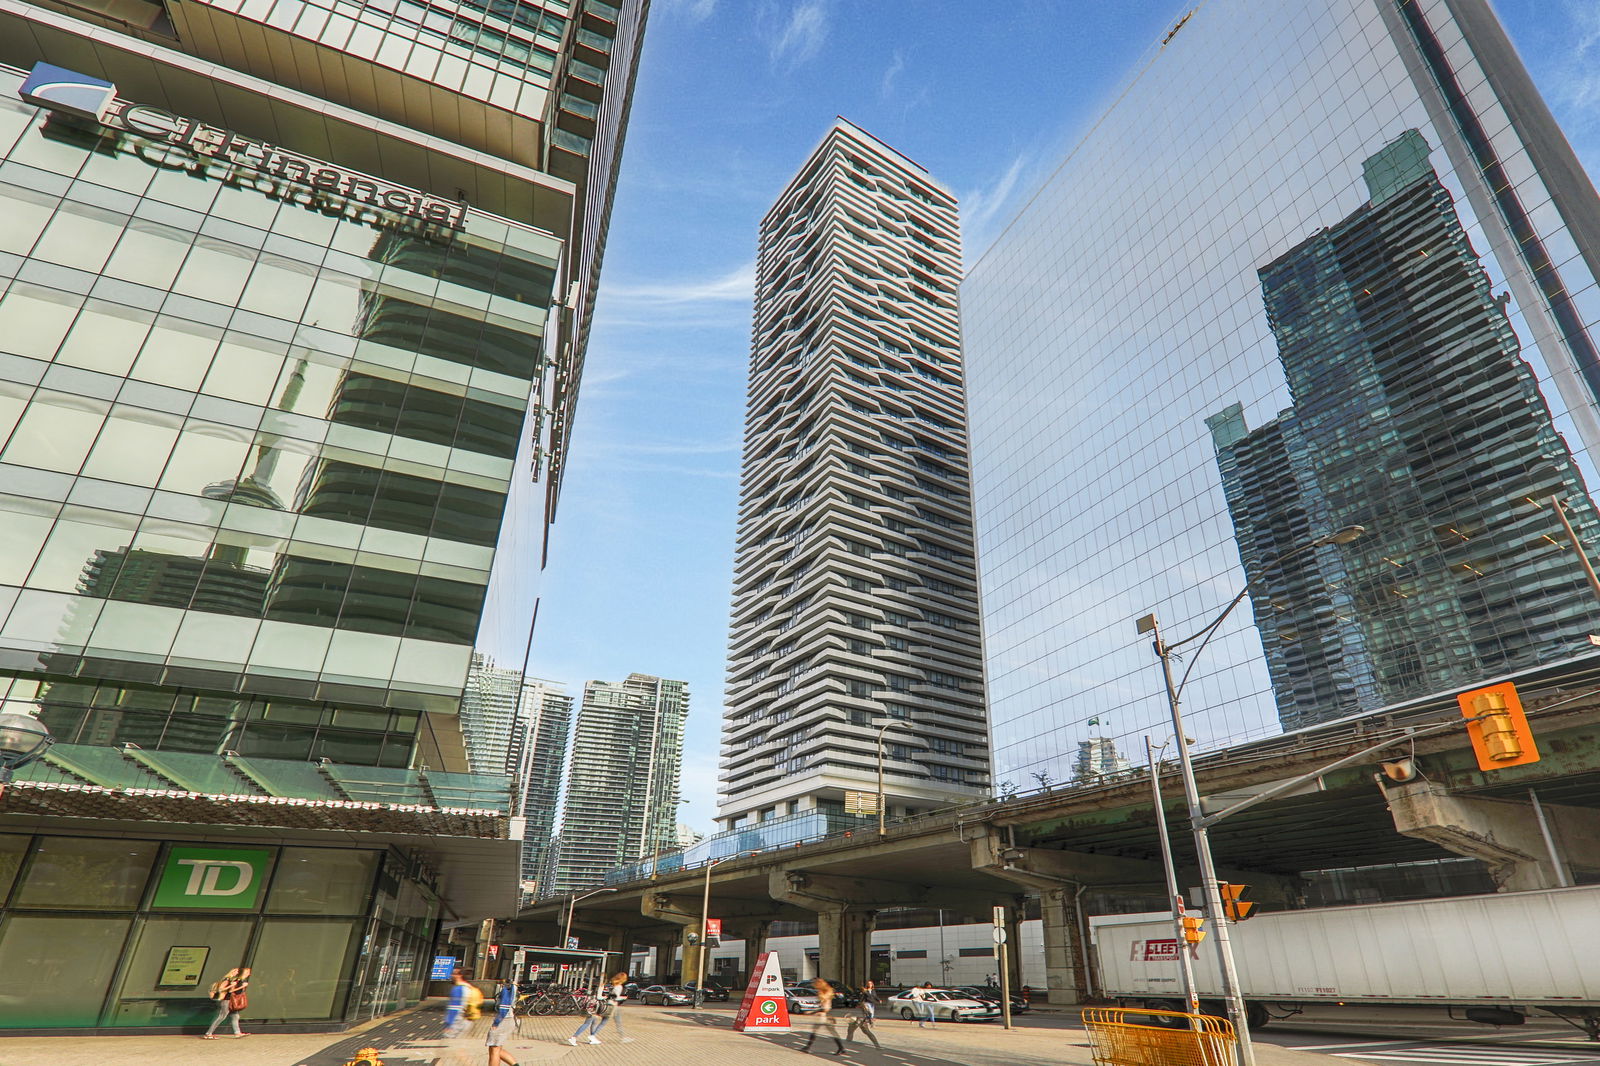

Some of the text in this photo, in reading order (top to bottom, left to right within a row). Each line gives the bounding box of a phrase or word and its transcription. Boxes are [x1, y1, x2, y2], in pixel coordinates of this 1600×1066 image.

[209, 129, 468, 232] Financial
[177, 860, 253, 895] TD
[756, 1015, 780, 1026] park
